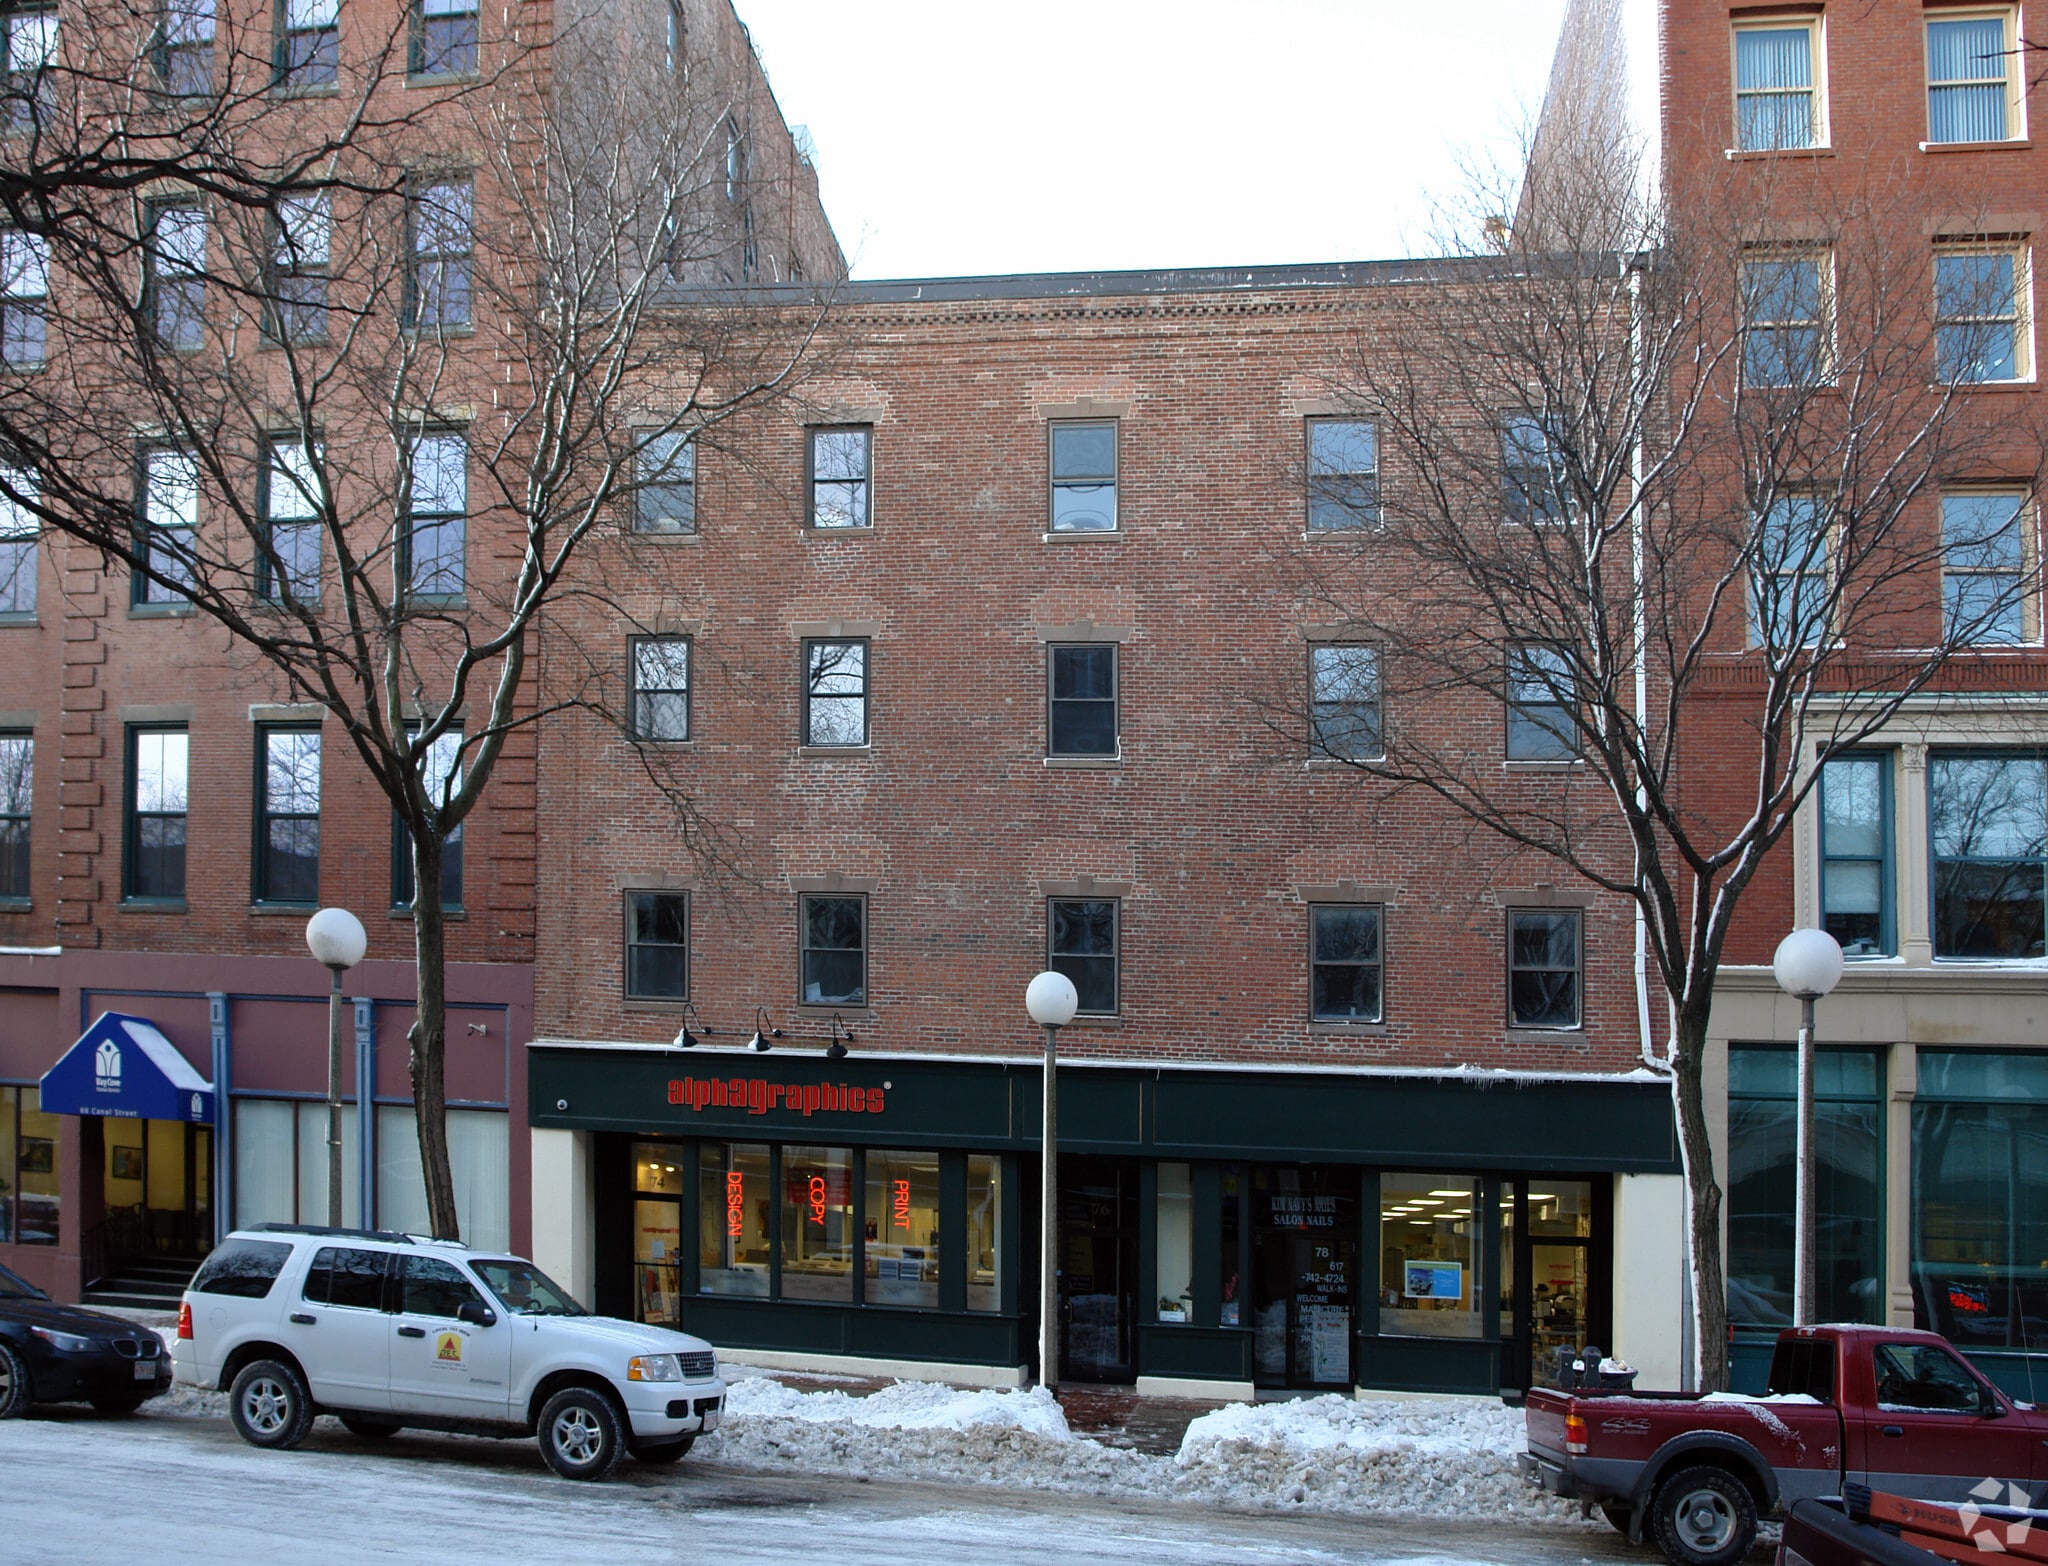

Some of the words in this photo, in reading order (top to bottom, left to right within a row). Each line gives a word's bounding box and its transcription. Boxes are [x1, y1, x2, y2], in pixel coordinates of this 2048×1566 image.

[667, 1076, 885, 1117] alphagraphics
[91, 1107, 112, 1116] Canal
[114, 1109, 138, 1117] Street
[650, 1176, 665, 1188] 74
[727, 1171, 743, 1237] DESIGN
[809, 1176, 826, 1226] COPY
[894, 1179, 910, 1231] PRINT
[1273, 1214, 1303, 1226] SALON
[1306, 1215, 1334, 1227] NAILS
[1315, 1247, 1329, 1258] 78
[1329, 1261, 1344, 1271] 617
[1316, 1284, 1348, 1294] WALK-INS
[1296, 1294, 1329, 1304] WELCOME
